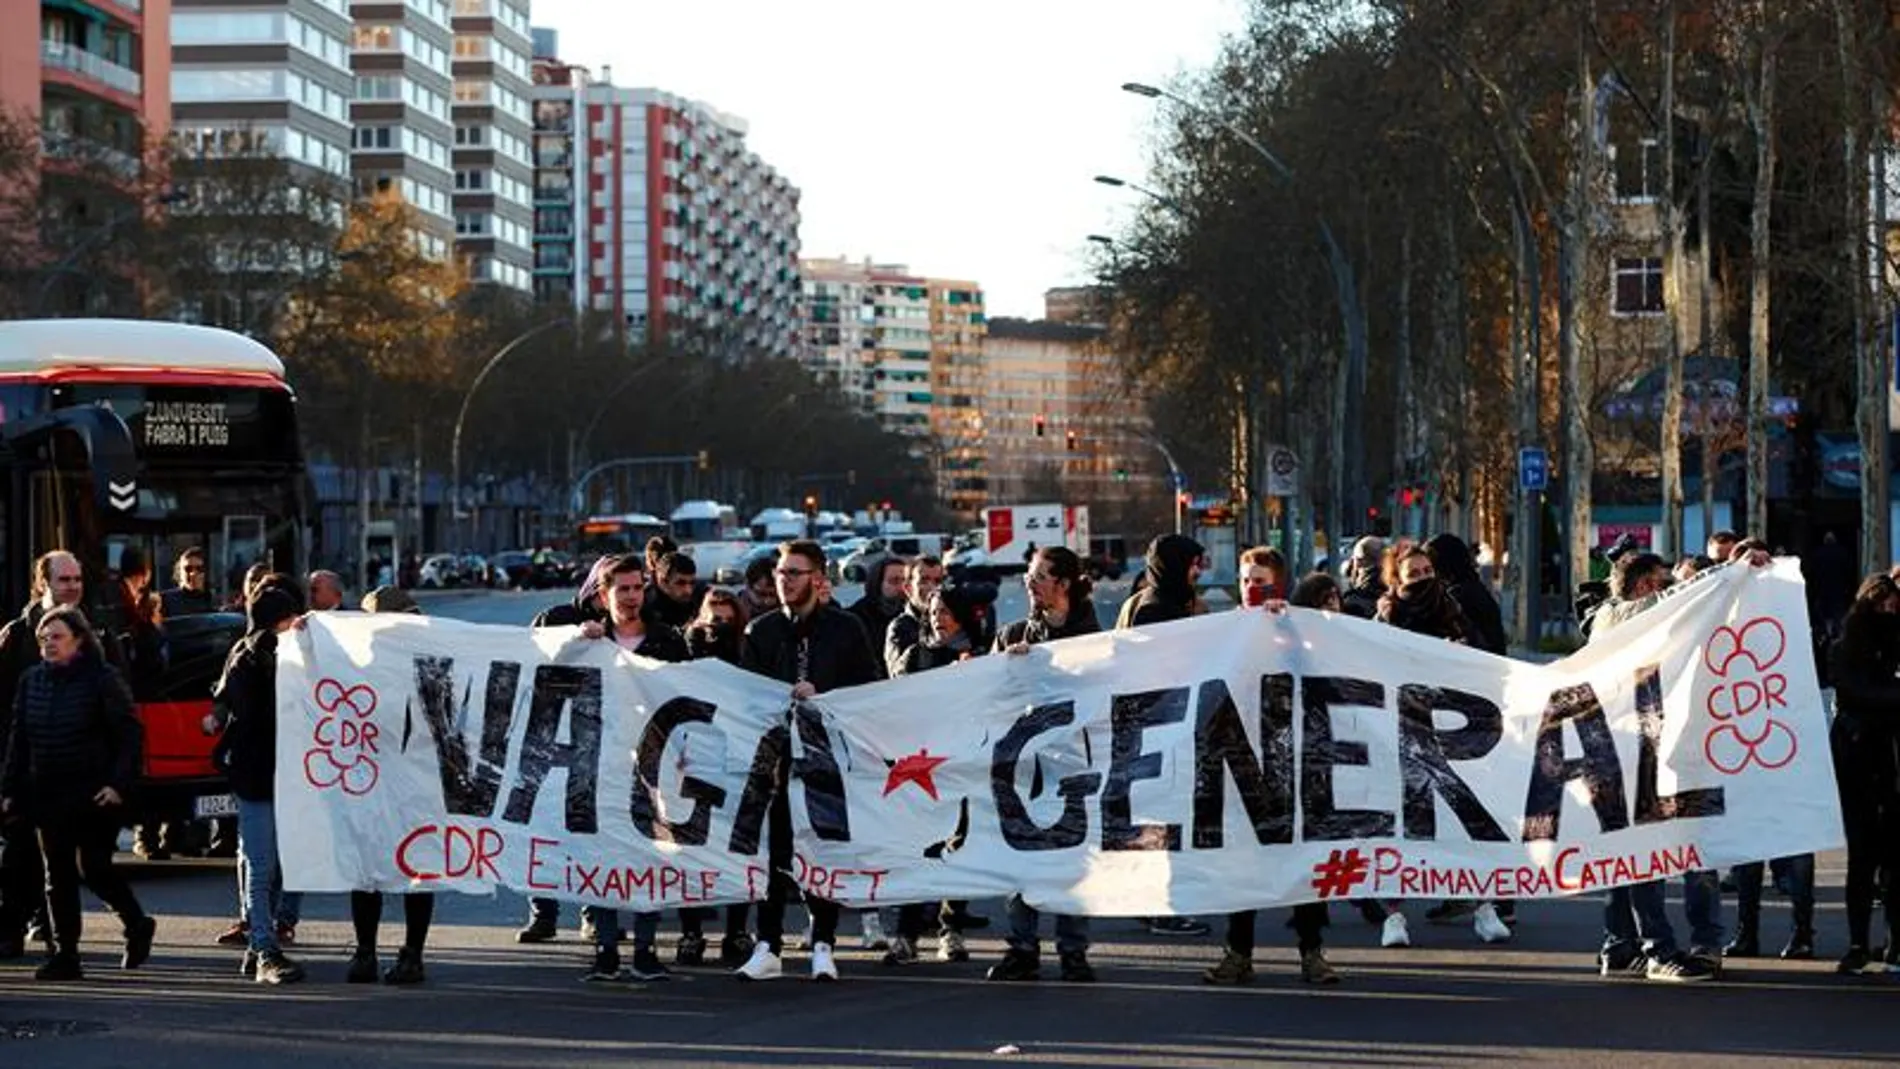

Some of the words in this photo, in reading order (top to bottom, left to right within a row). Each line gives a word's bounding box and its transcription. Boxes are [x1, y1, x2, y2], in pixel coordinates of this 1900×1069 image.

[145, 424, 187, 446] FABRA
[189, 424, 196, 446] I
[199, 424, 229, 446] PUIG
[1707, 673, 1787, 720] CDR
[314, 717, 379, 754] CDR
[992, 663, 1725, 851] GENERAL
[395, 824, 503, 881] CDR
